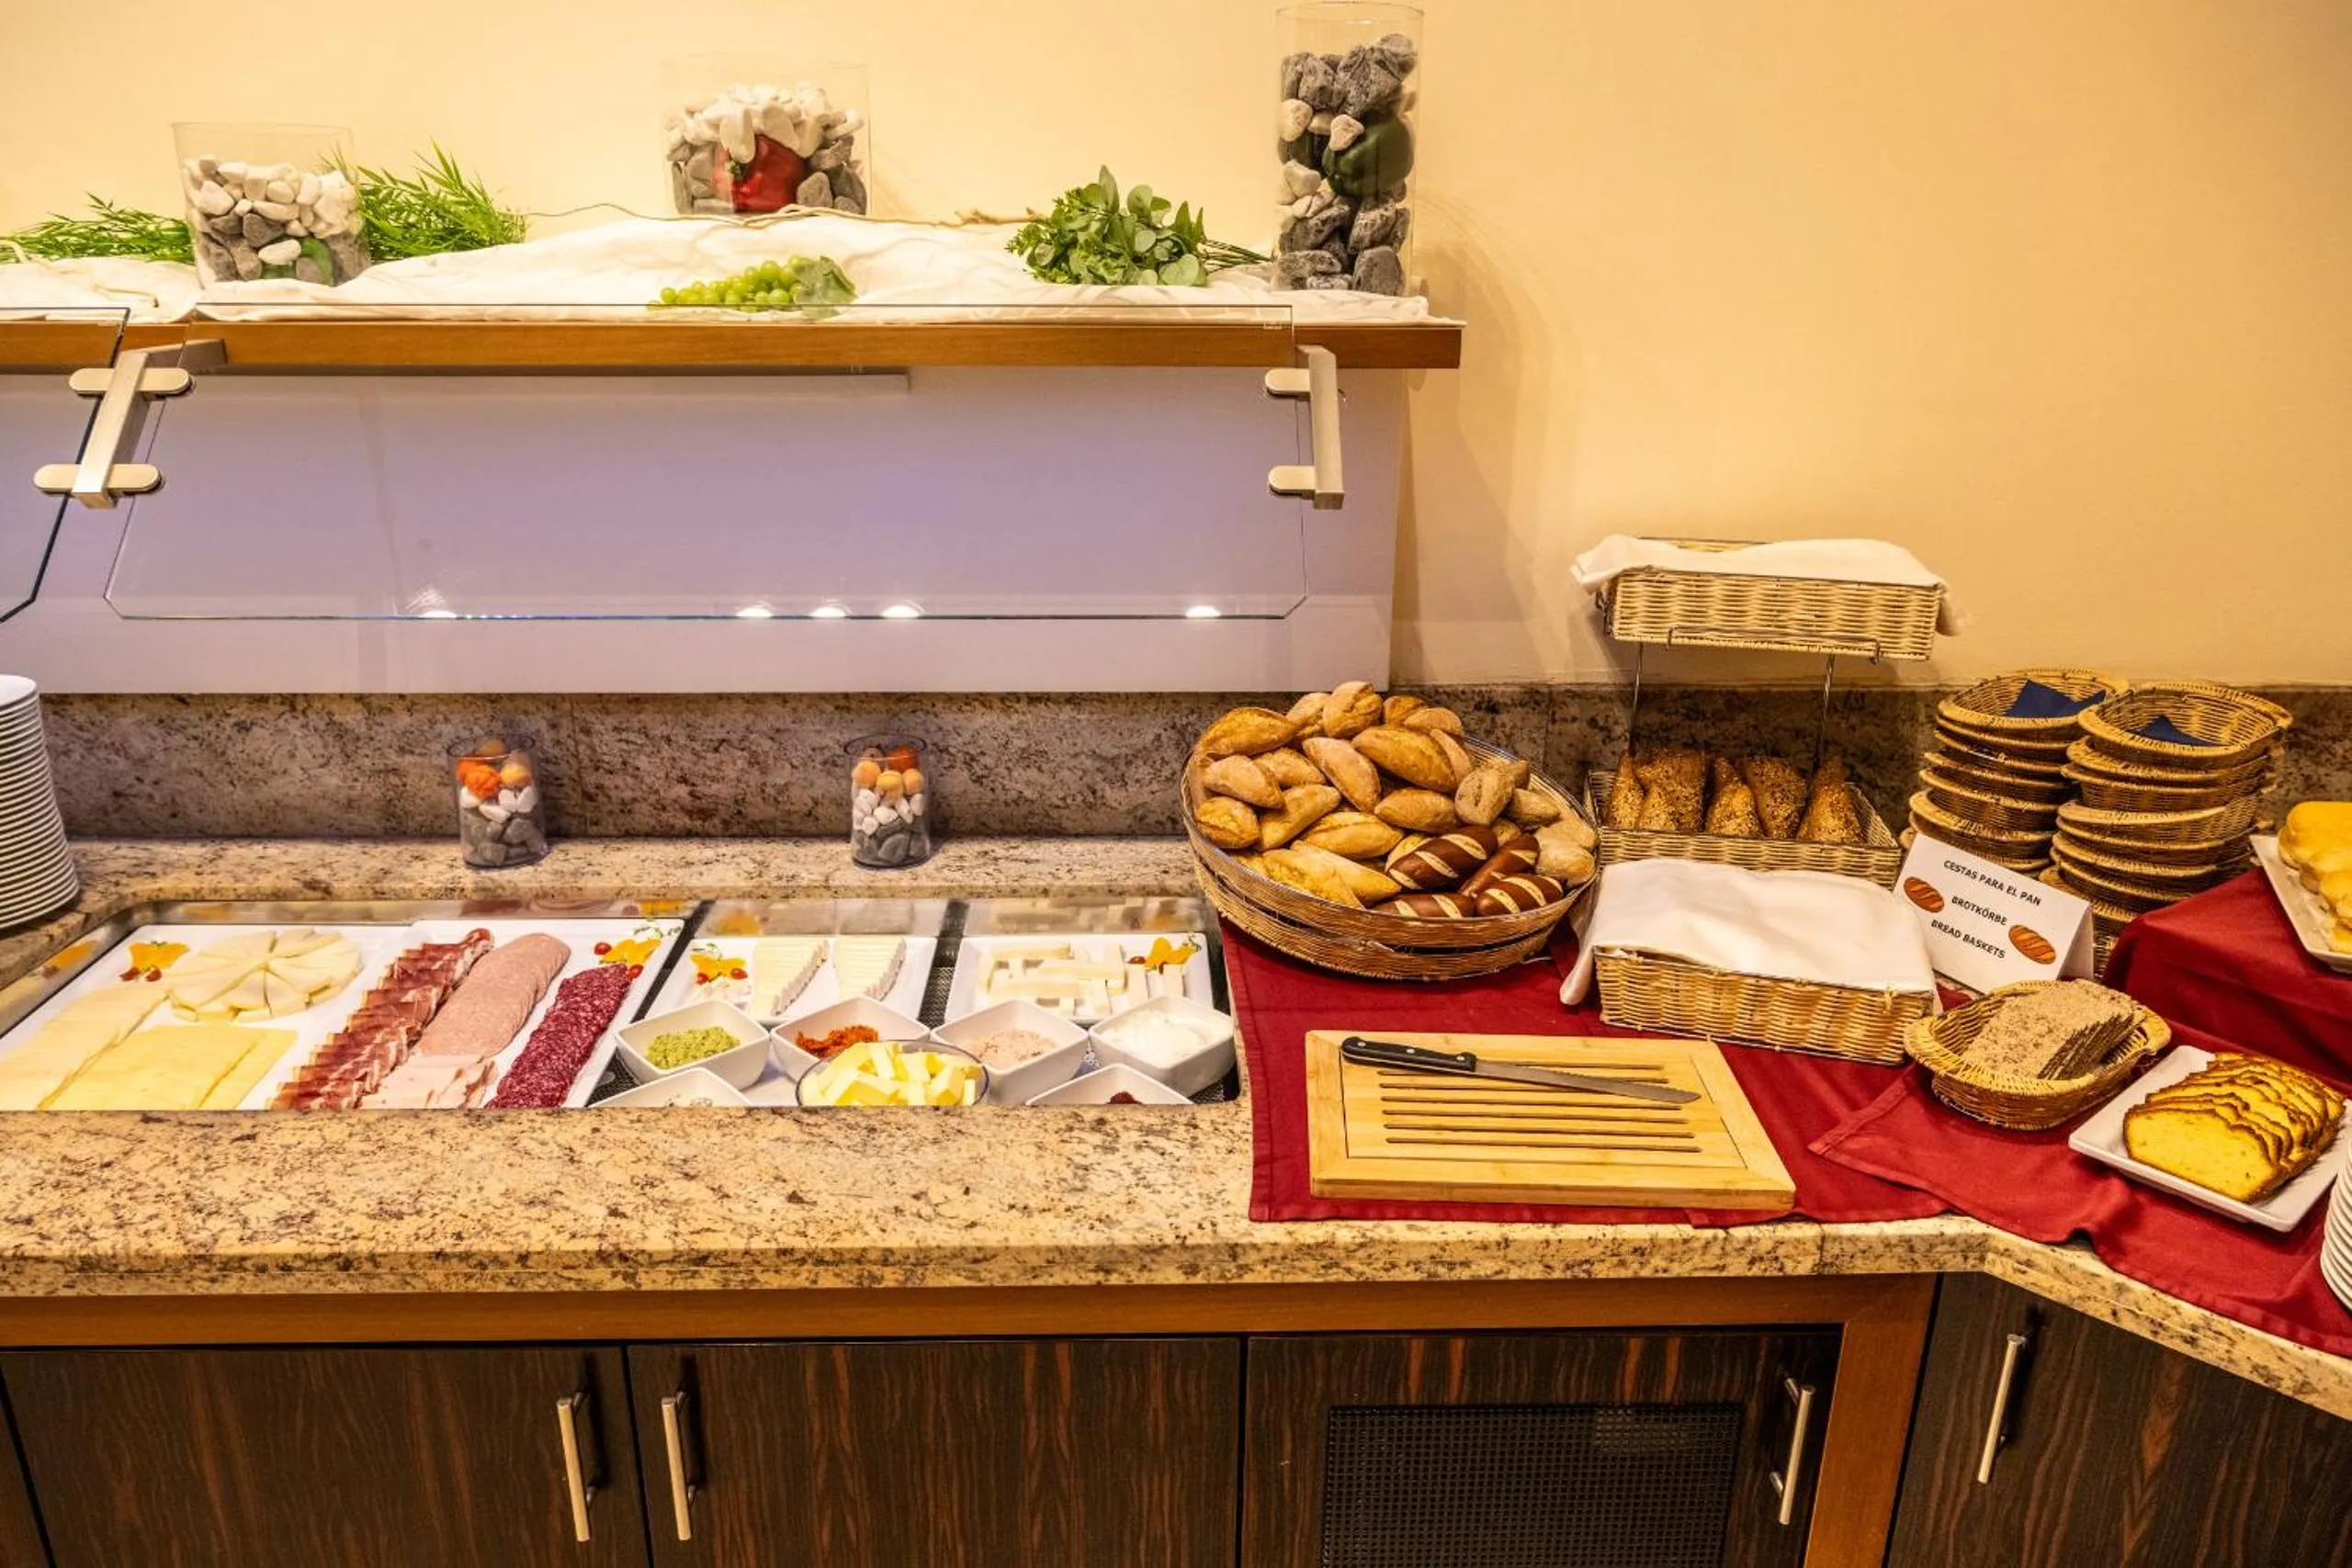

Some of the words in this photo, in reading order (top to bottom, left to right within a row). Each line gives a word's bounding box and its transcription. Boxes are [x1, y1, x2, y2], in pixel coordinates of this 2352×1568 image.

[1943, 860, 1978, 880] CESTAS
[1979, 874, 2004, 891] PARA
[2006, 886, 2018, 897] EL
[2019, 890, 2041, 907] PAN
[1951, 896, 2008, 926] BROTKÖRBE
[1931, 919, 1962, 939] BREAD
[1962, 933, 2007, 959] BASKETS
